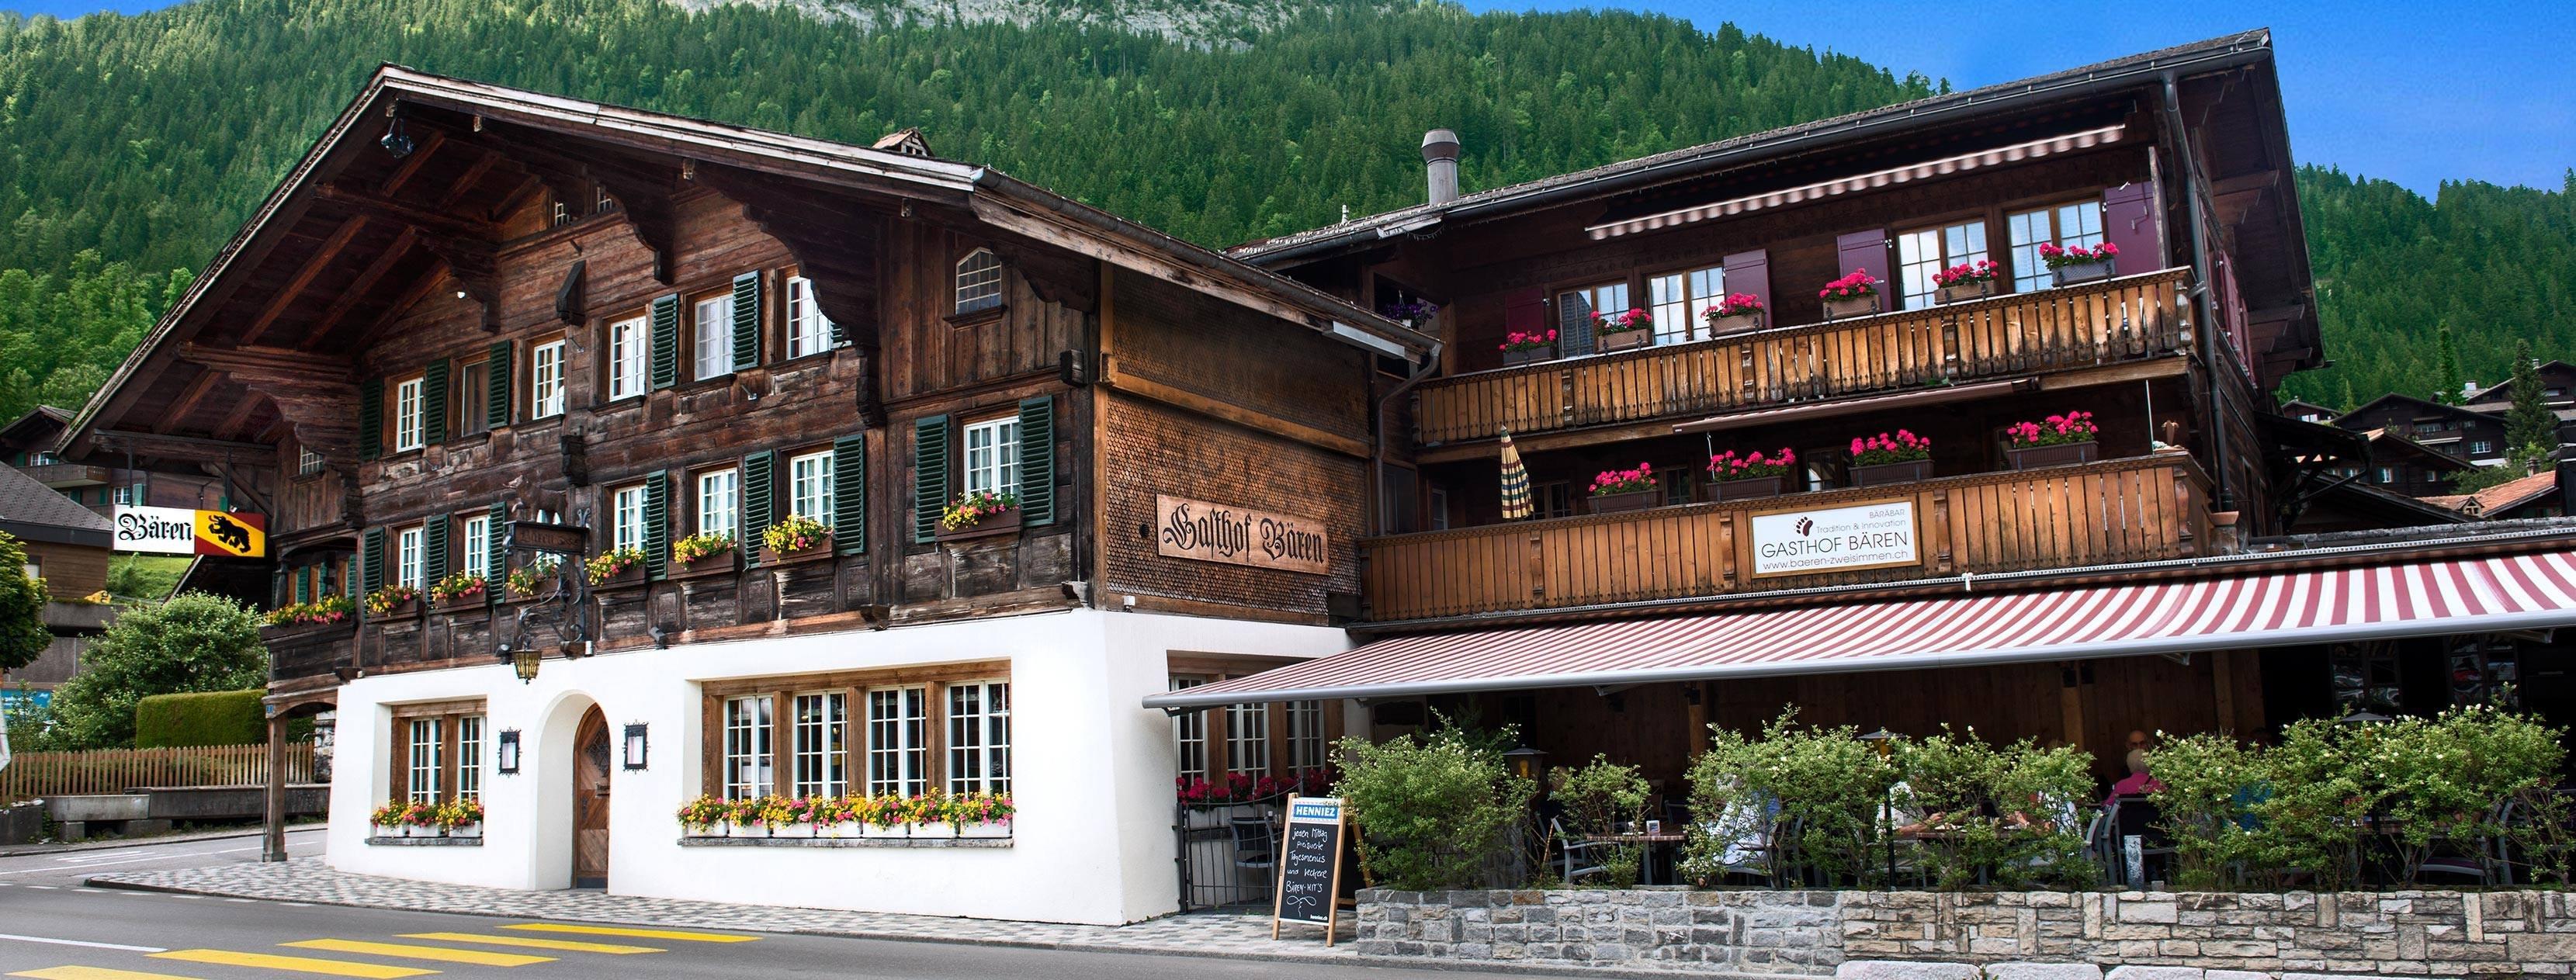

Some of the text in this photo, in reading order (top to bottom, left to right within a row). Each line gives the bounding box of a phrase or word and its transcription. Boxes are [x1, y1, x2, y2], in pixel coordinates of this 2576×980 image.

[1869, 508, 1905, 519] BÄRÄBAR
[118, 513, 192, 541] Bären
[1163, 503, 1324, 564] Gasthof Bären
[1816, 519, 1906, 534] Tradition & Innovation
[1761, 532, 1907, 558] GASTHOF BÄREN
[1763, 550, 1908, 570] www.baeren-zweisimmen.ch
[1295, 806, 1335, 817] HENNIEZ
[1292, 828, 1309, 840] jeden
